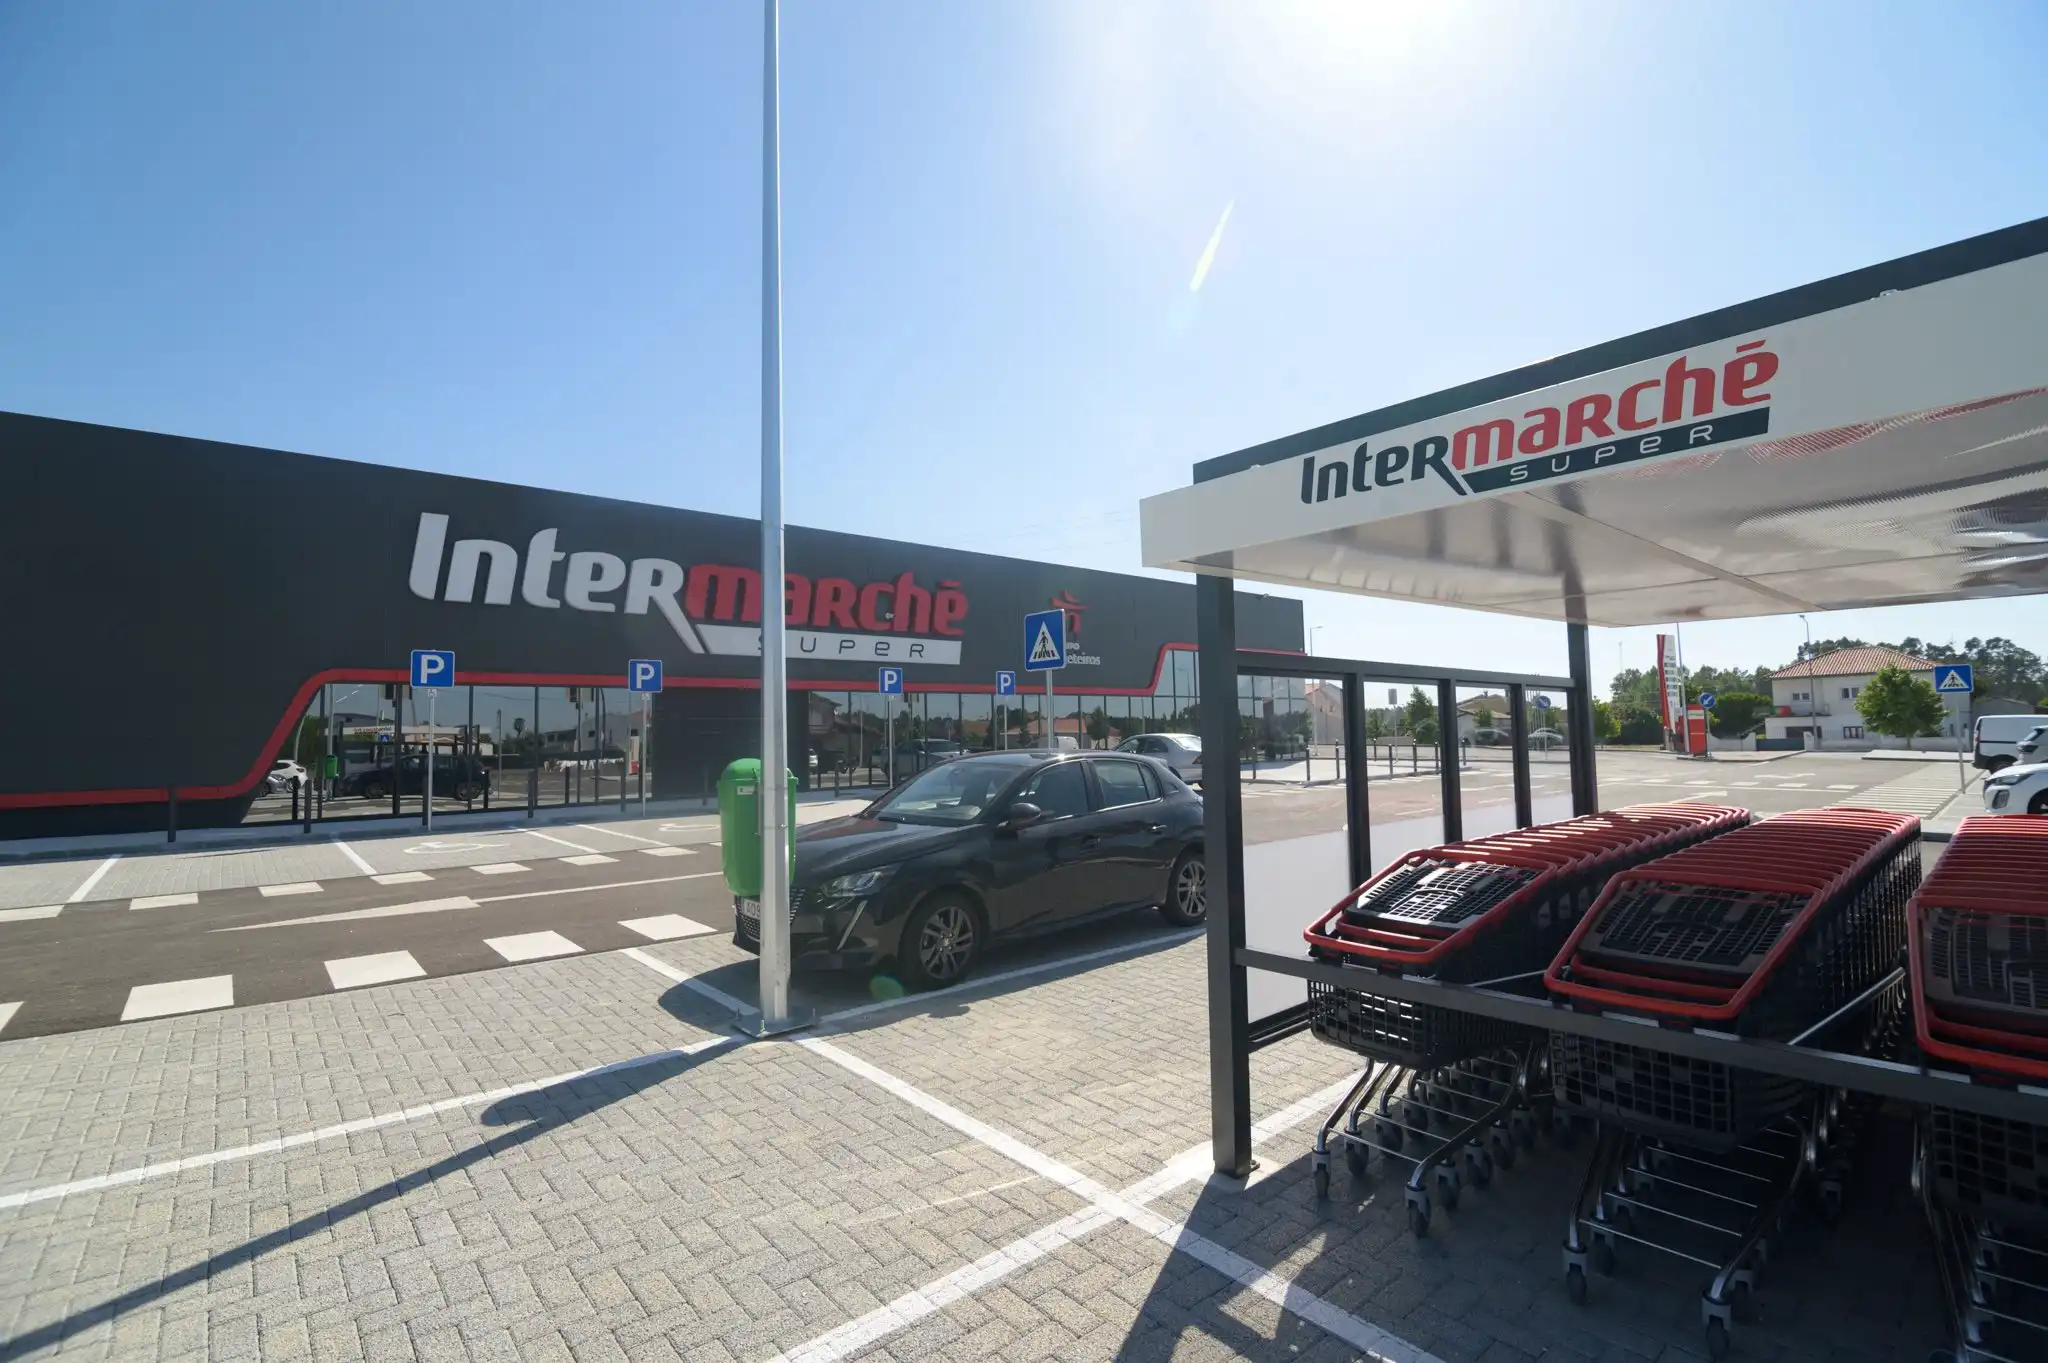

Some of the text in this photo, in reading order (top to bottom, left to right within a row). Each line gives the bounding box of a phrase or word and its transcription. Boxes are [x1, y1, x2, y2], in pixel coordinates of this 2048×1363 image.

[420, 655, 445, 684] P
[636, 663, 654, 689] P
[885, 671, 898, 691] P
[1000, 674, 1011, 694] P
